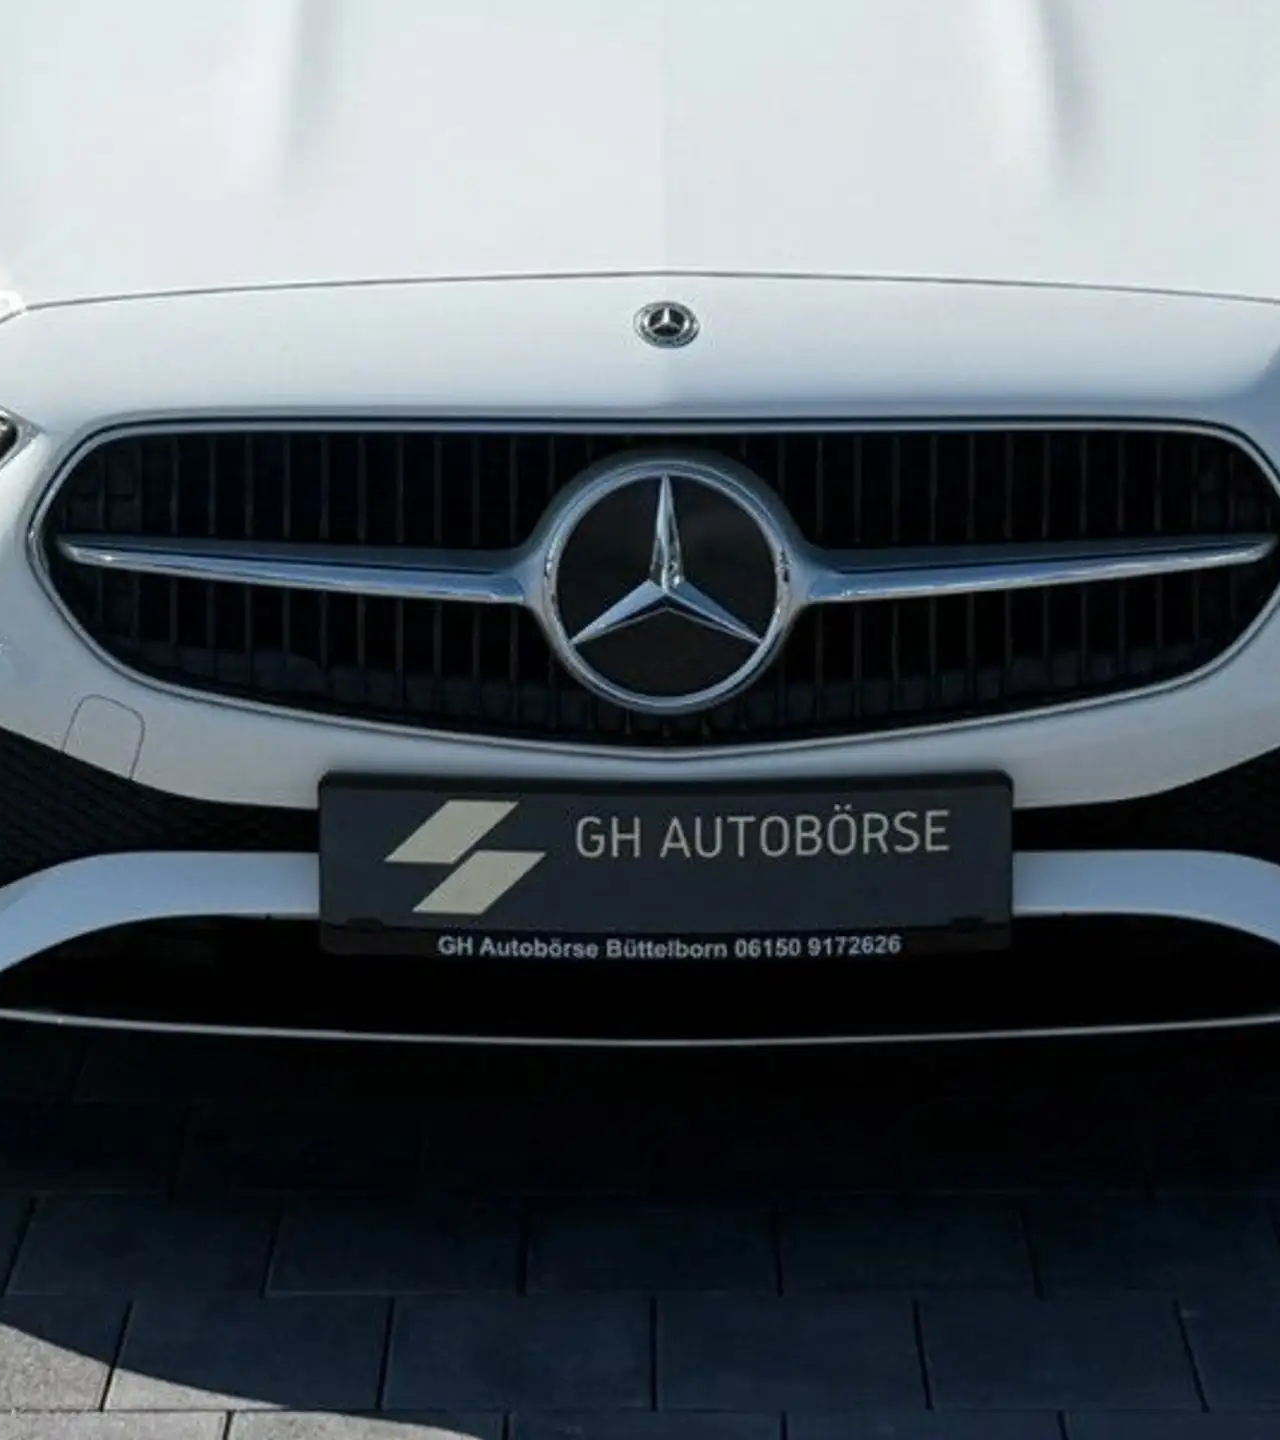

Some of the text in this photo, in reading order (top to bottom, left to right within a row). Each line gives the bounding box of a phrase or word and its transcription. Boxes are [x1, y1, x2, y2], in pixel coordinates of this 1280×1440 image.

[576, 803, 950, 858] GH AUTOBÖRSE
[438, 934, 902, 959] GH Autobörse Büttelborn 06150 9172626
